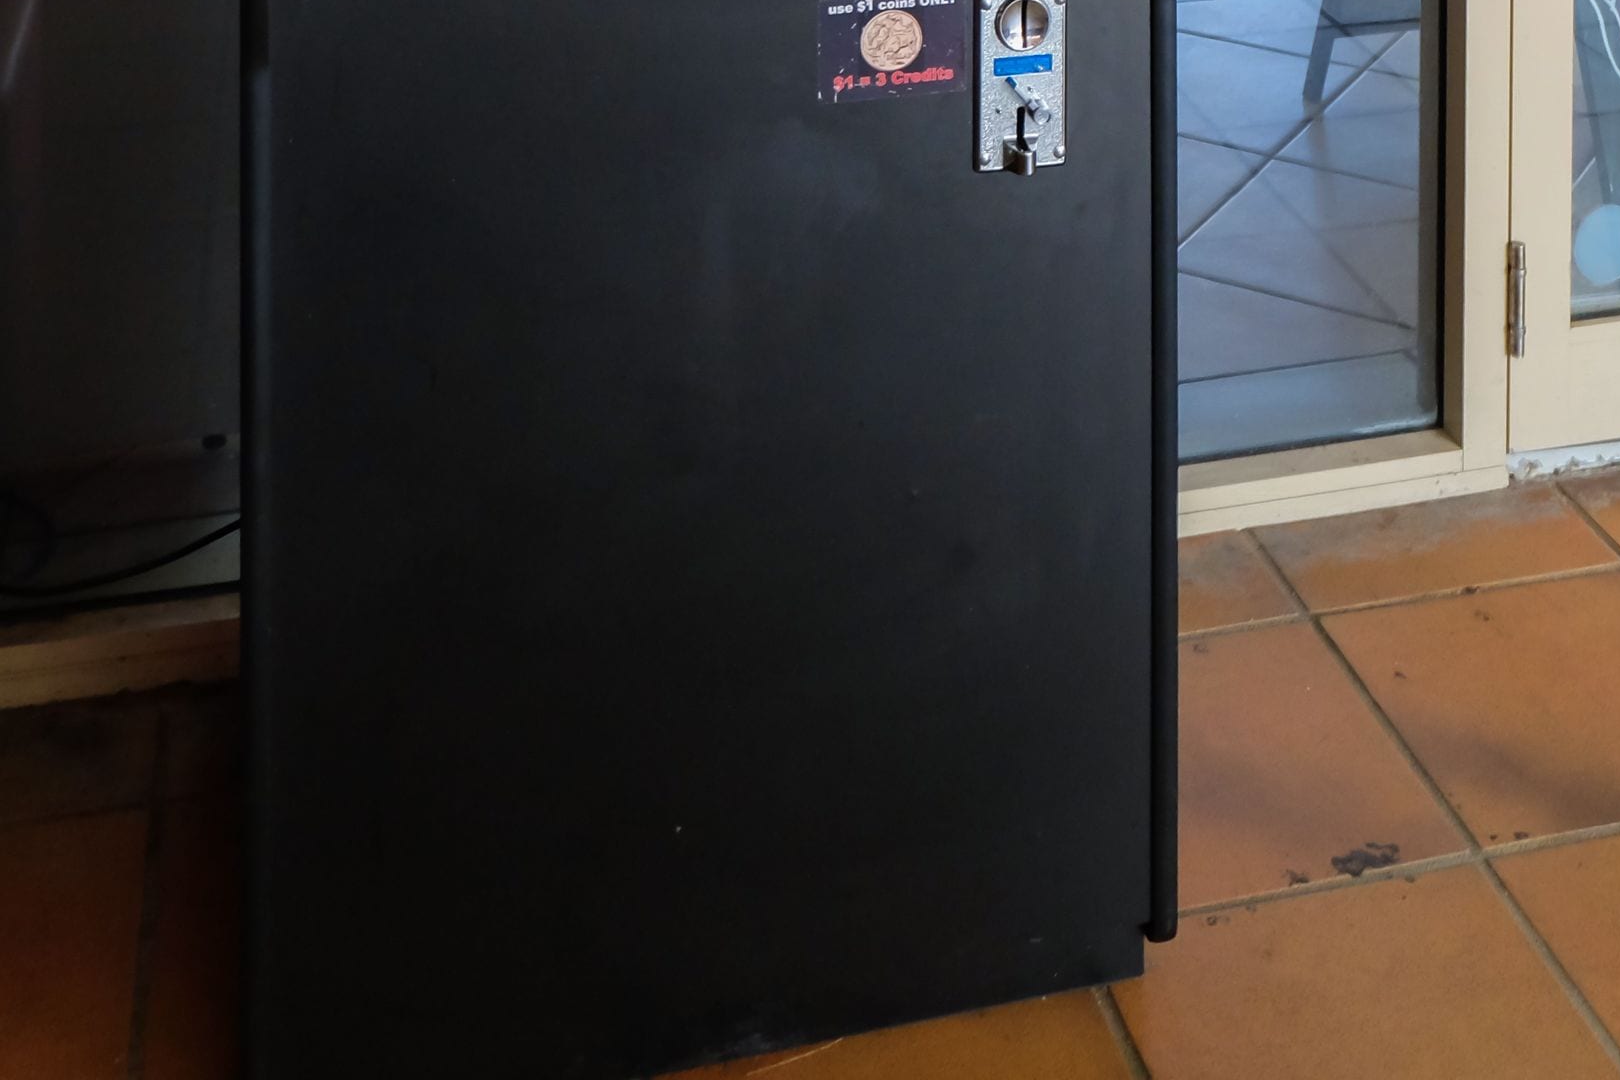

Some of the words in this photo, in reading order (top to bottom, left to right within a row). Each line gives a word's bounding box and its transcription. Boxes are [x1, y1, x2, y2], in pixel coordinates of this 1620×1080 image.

[828, 4, 854, 15] use
[833, 74, 854, 92] $1
[875, 72, 887, 86] 3
[891, 66, 954, 85] Credits
